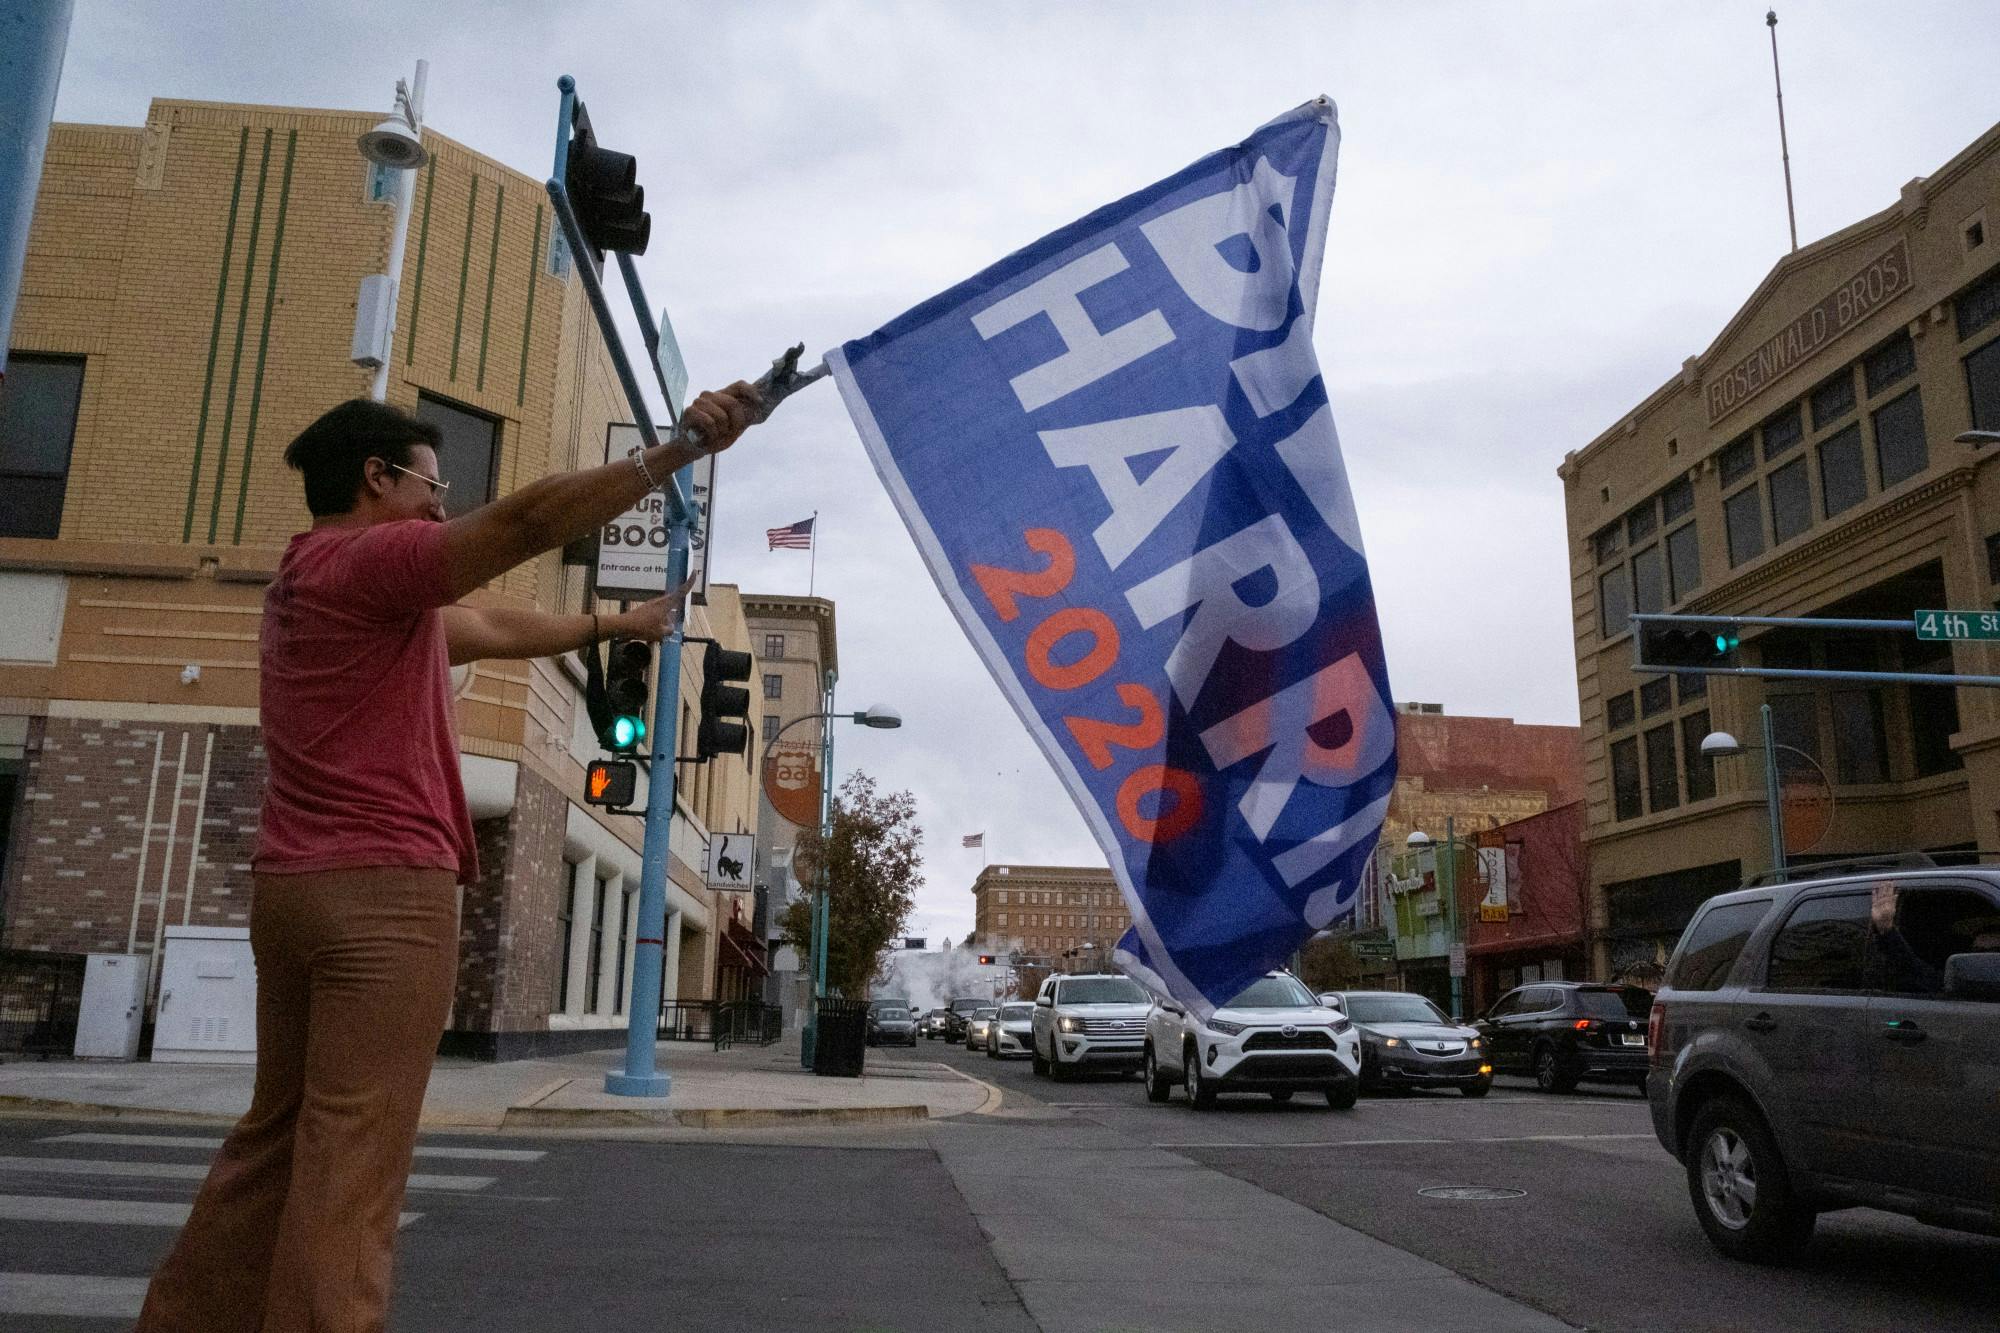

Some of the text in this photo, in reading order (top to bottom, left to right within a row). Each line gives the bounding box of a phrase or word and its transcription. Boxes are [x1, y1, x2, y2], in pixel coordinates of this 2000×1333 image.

[1712, 308, 1826, 417] ROSENWALD
[602, 523, 705, 551] BOOS
[600, 563, 641, 573] Entrance
[643, 564, 654, 573] at
[1921, 613, 1998, 638] 4th St
[970, 527, 1203, 844] 2020
[708, 881, 749, 890] sandwiches
